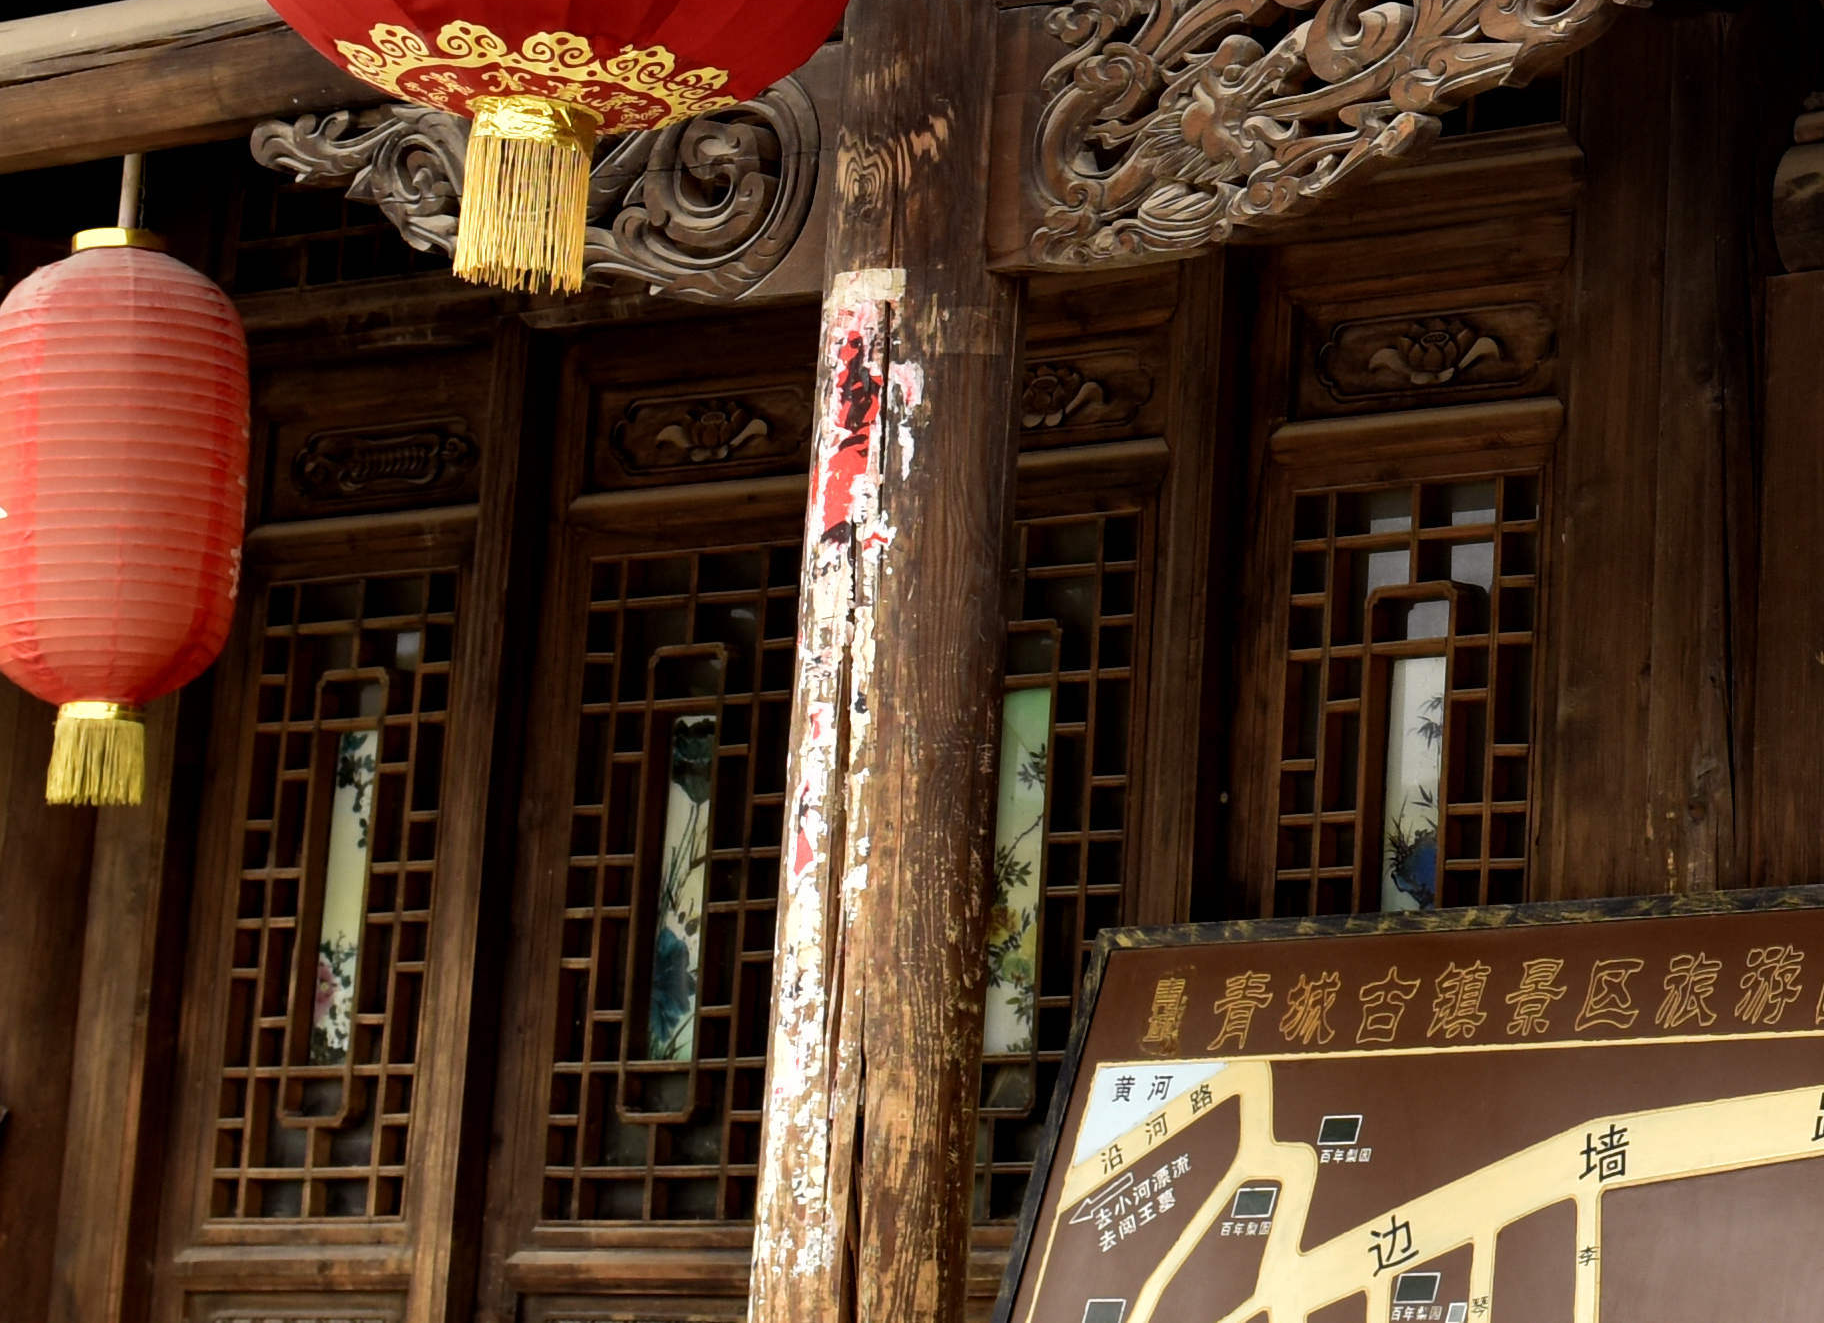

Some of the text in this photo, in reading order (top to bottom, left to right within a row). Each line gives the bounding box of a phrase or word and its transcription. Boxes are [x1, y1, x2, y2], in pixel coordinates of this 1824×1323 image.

[1112, 1075, 1173, 1102] 黄河
[1101, 1084, 1213, 1174] 沿河路
